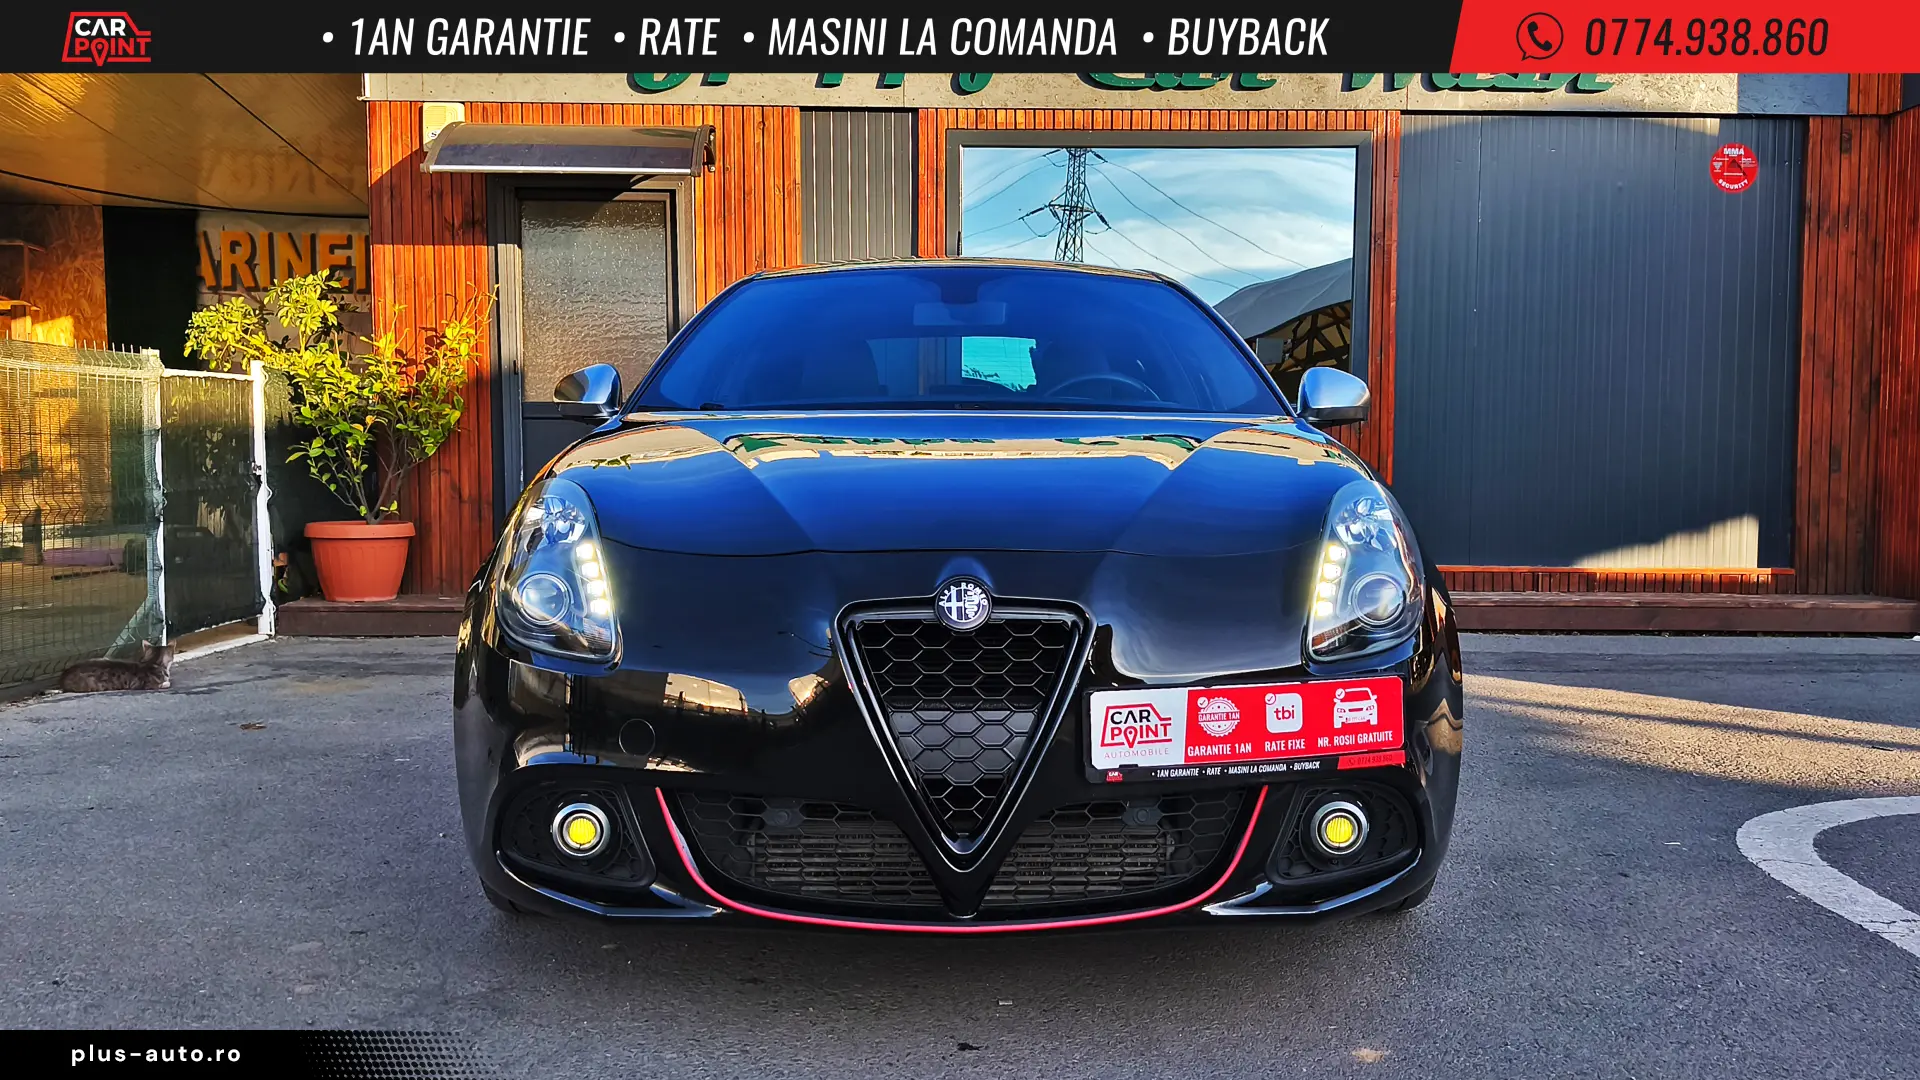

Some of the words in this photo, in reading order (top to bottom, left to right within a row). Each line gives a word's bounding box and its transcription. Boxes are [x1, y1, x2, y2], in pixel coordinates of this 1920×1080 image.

[1723, 147, 1745, 155] MMA
[1718, 178, 1748, 190] SECURITY
[961, 582, 988, 606] ROMEO
[1110, 708, 1151, 725] CAR
[1198, 712, 1227, 723] GARANTIE
[1273, 704, 1295, 721] tbi
[1110, 722, 1172, 749] POINT
[1317, 736, 1332, 748] NR.
[1333, 734, 1356, 747] ROSII
[1357, 730, 1393, 744] GRATUITE
[1187, 743, 1232, 757] GARANTIE
[1234, 742, 1252, 754] 1AN
[1264, 740, 1286, 752] RATE
[1287, 738, 1306, 750] FIXE
[1104, 747, 1169, 760] AUTOMOBILE
[1169, 768, 1200, 778] GARANTIE
[1206, 766, 1221, 776] RATE
[1228, 764, 1250, 775] MASINI
[1250, 764, 1258, 774] LA
[1258, 763, 1287, 773] COMANDA
[1293, 761, 1321, 771] BUYBACK
